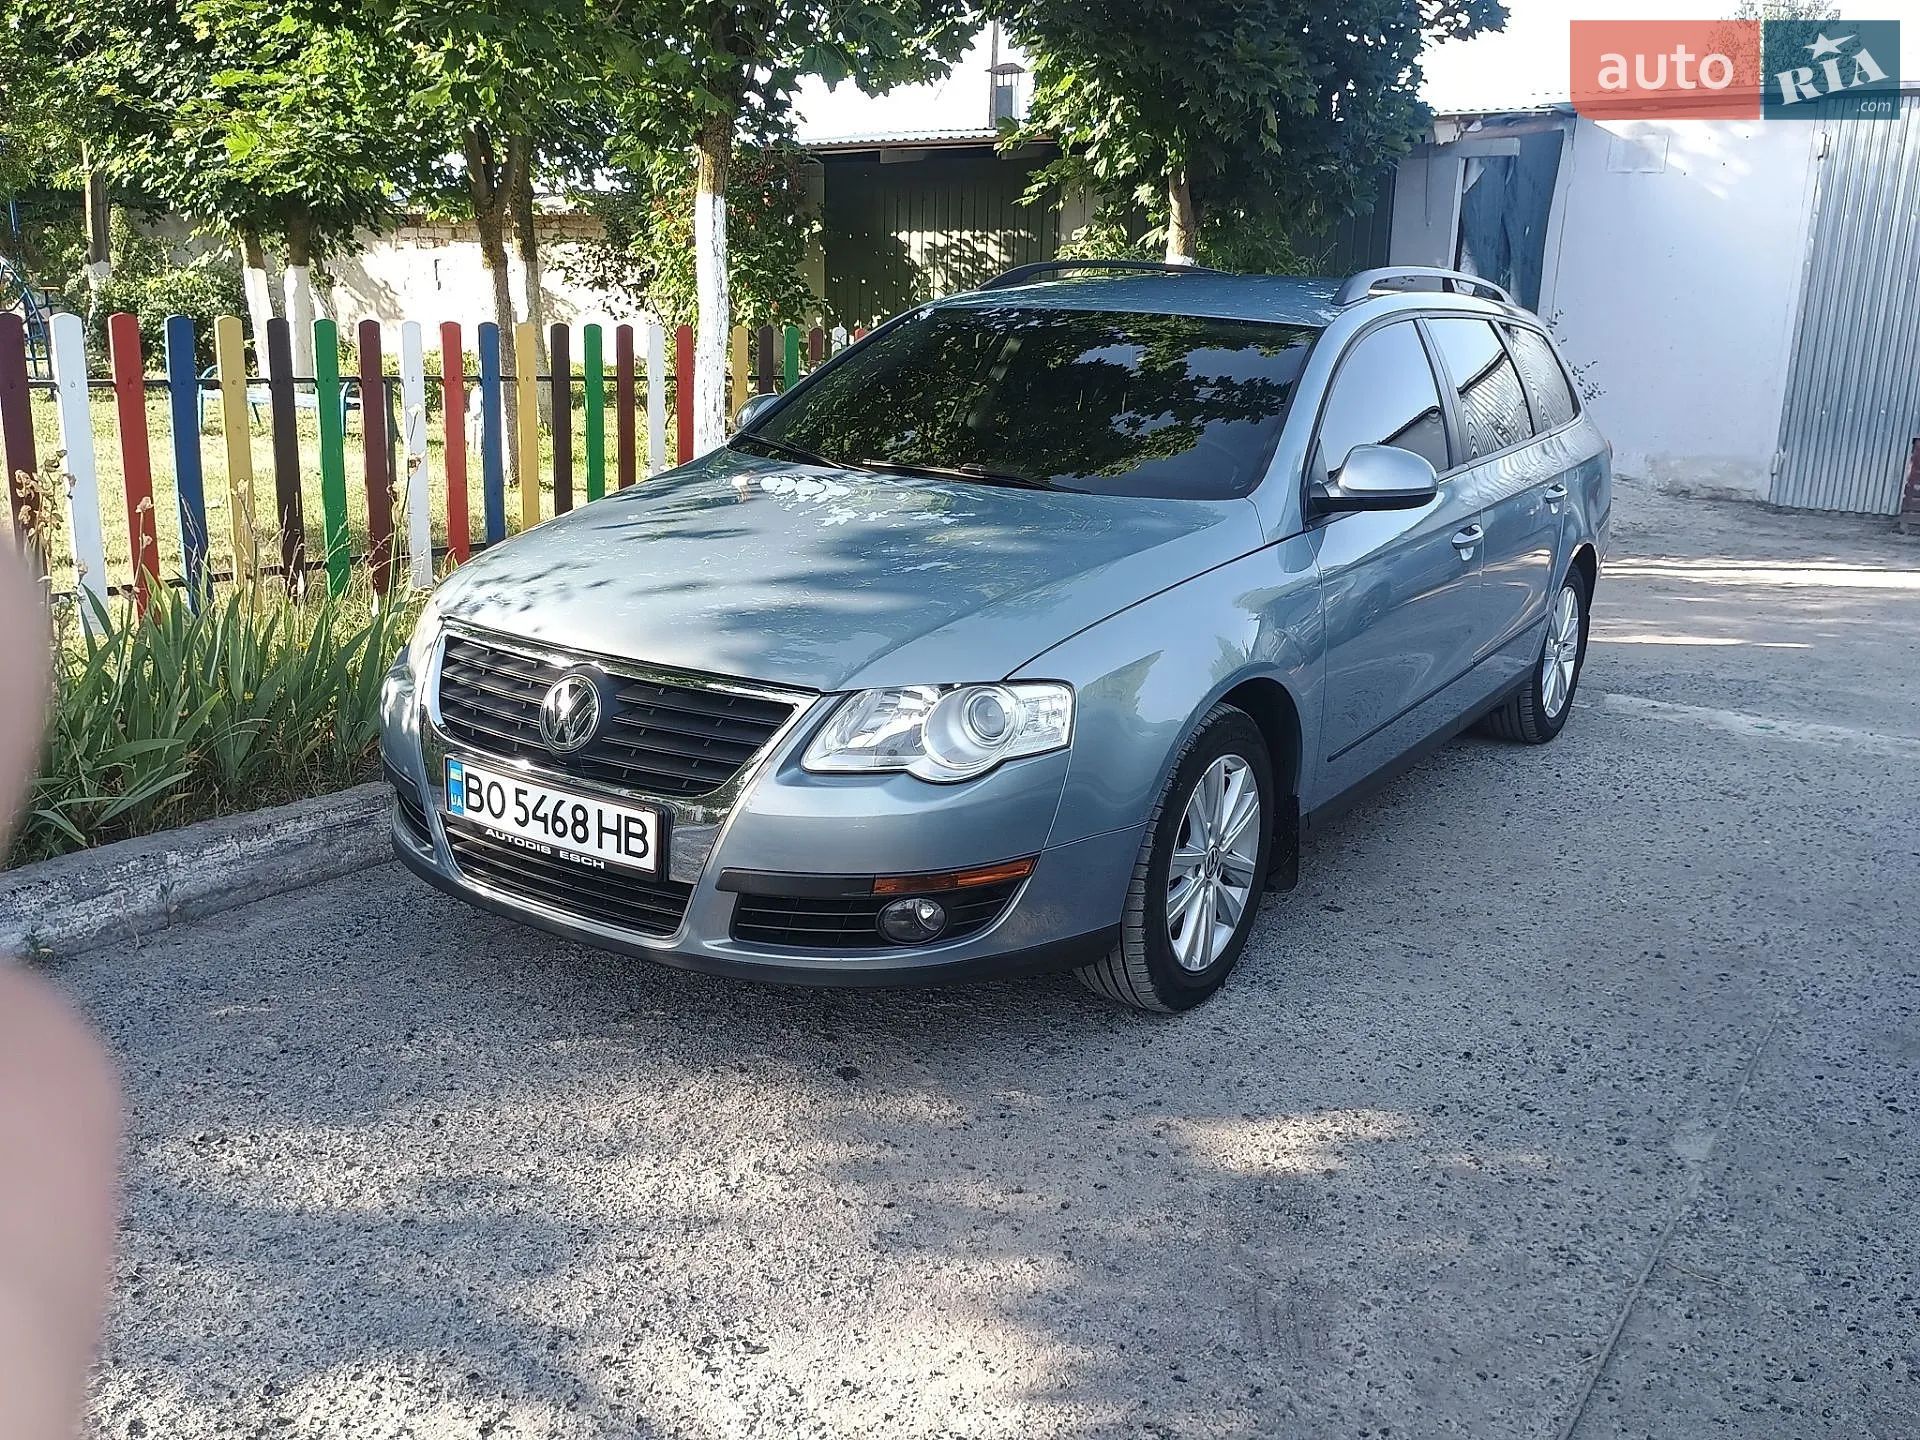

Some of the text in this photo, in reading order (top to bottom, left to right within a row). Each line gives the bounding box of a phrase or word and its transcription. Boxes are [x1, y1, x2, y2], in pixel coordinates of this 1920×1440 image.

[450, 793, 463, 808] UA
[464, 771, 649, 859] BO 5468 HB
[485, 828, 605, 870] AUTODIS ESCH
